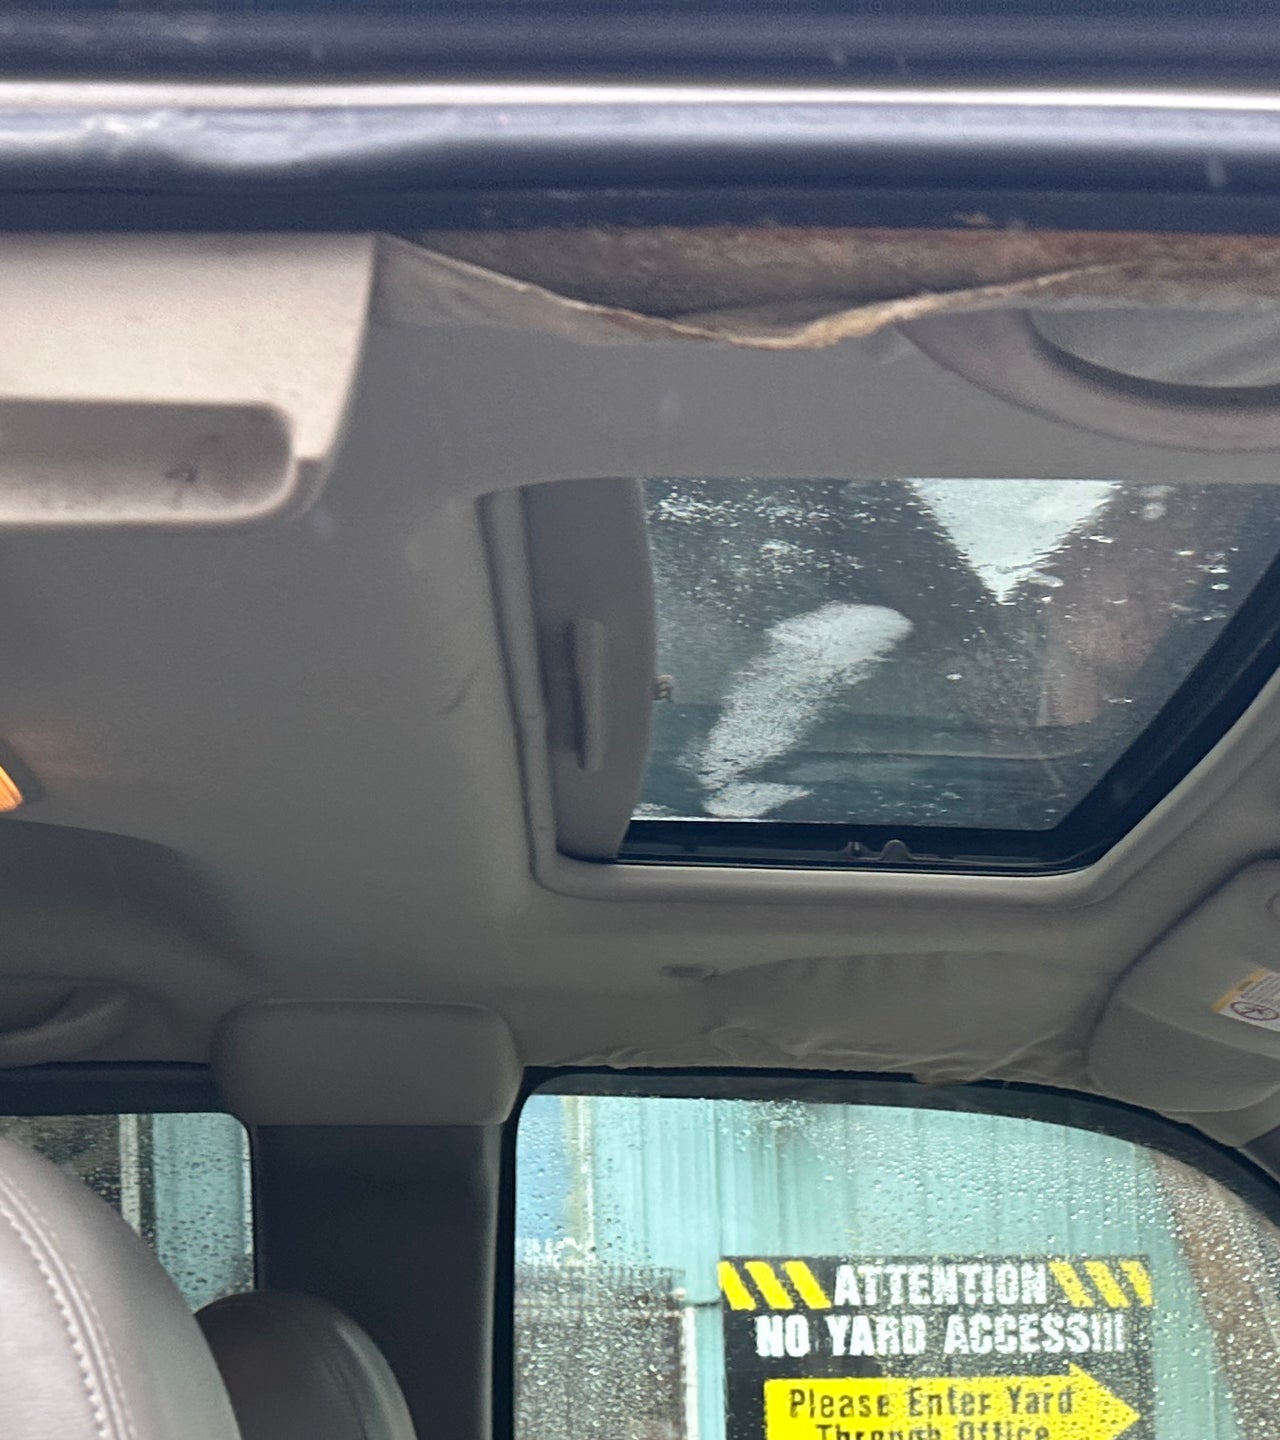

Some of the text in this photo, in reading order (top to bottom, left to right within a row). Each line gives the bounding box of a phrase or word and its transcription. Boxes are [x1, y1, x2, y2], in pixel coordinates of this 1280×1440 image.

[834, 1264, 1047, 1306] ATTENTION
[754, 1314, 811, 1358] NO
[826, 1314, 927, 1357] YARD
[788, 1382, 1076, 1420] Please Enter Yard
